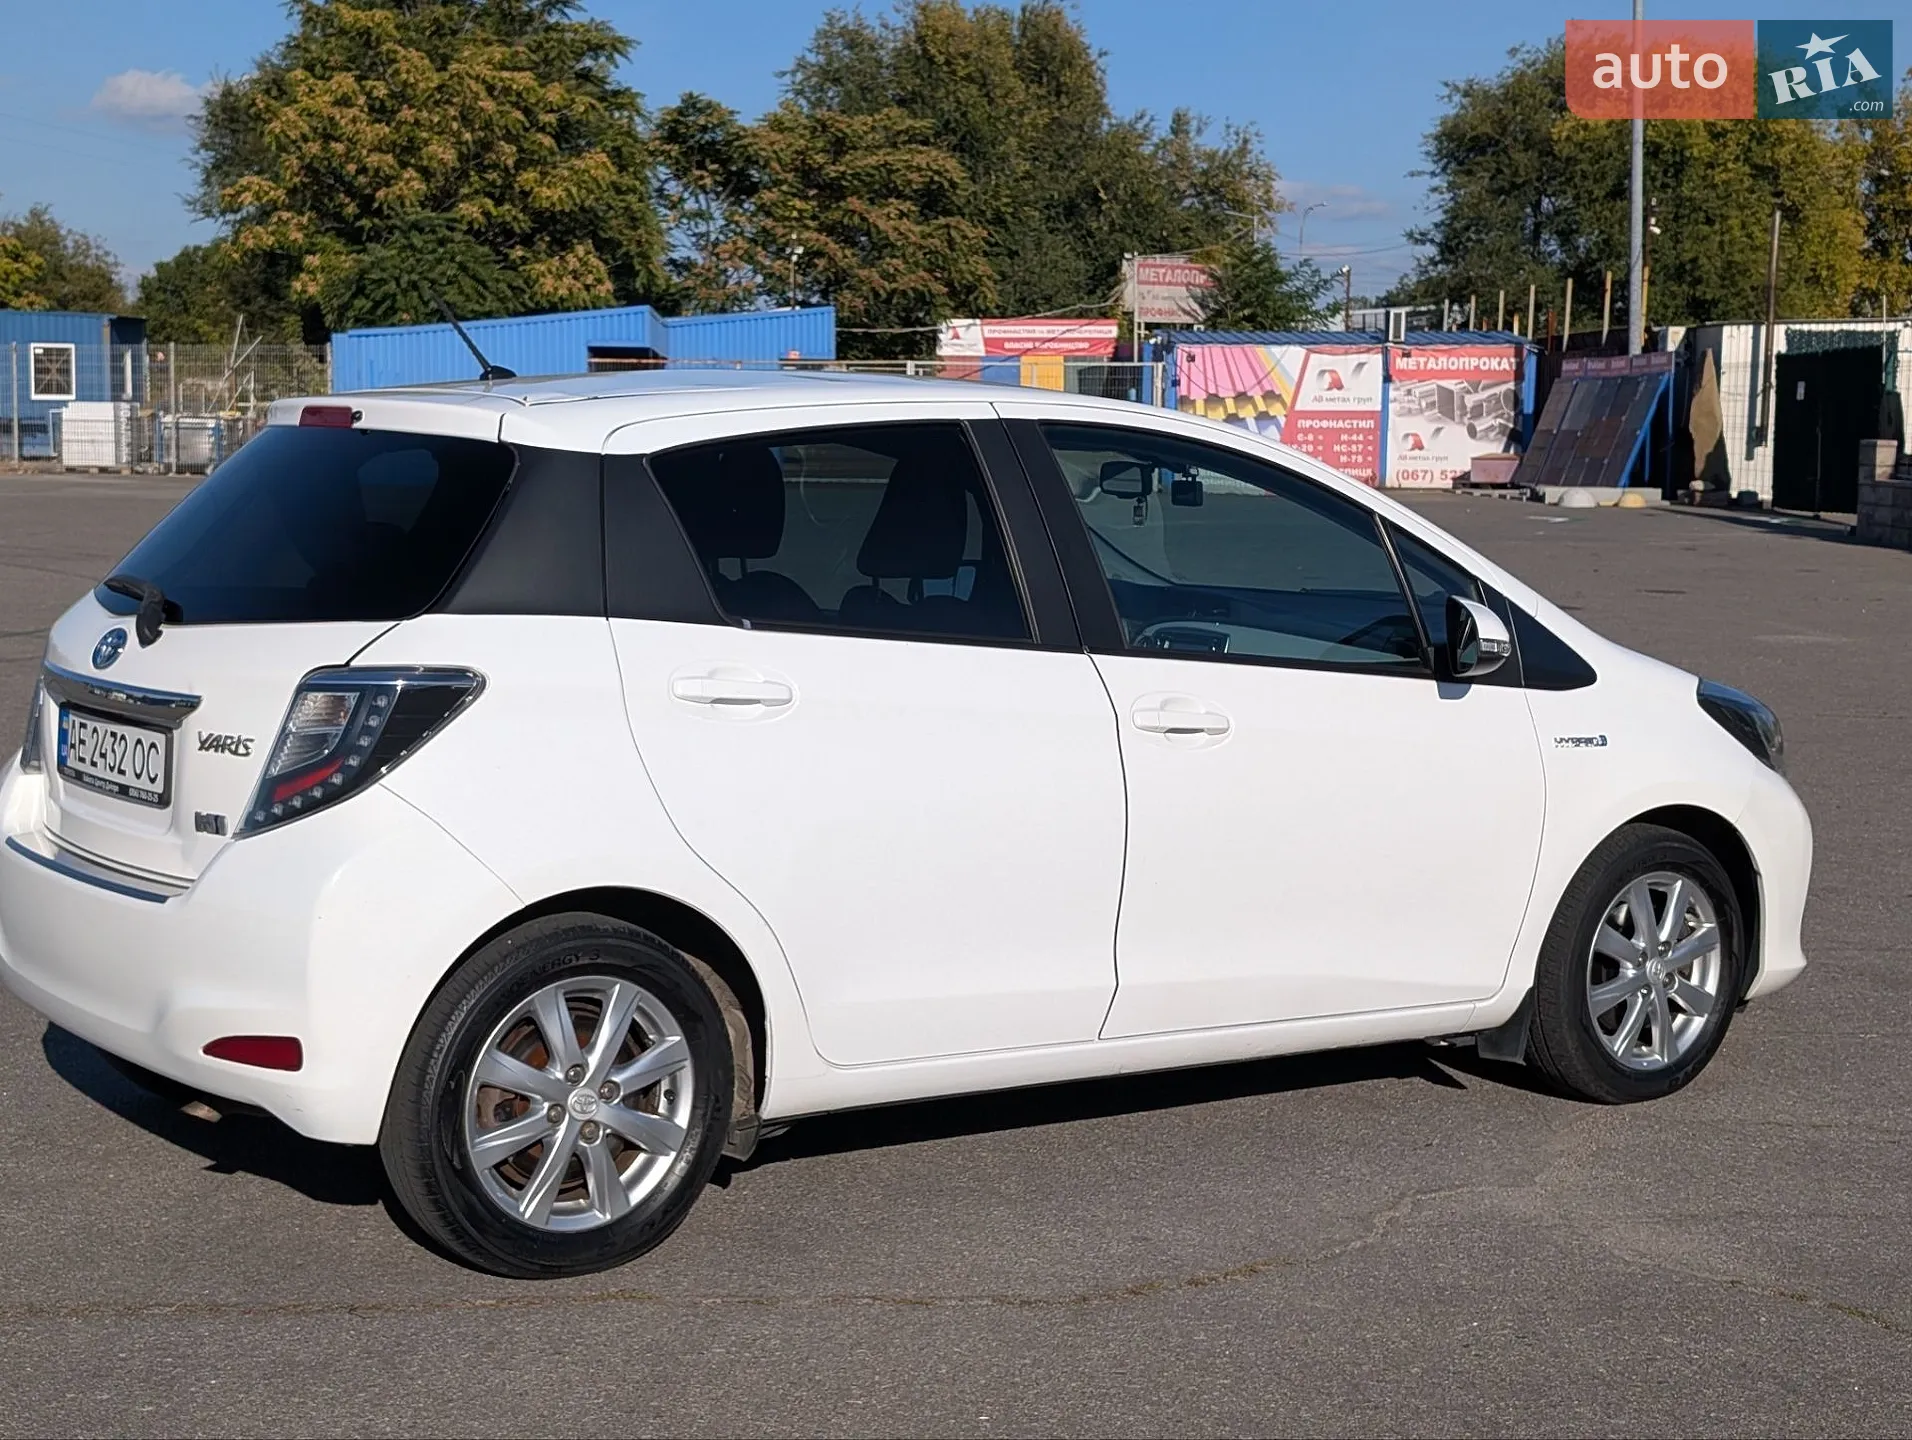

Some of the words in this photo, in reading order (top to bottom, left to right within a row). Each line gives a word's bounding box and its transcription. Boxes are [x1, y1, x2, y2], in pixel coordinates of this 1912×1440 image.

[1395, 356, 1517, 371] МЕТАЛОПРОКАТ
[1297, 419, 1375, 430] ПРОФНАСТИЛ
[1396, 469, 1434, 484] (067)
[198, 730, 255, 757] YARIS
[69, 719, 88, 764] AE
[90, 725, 128, 776] 2432
[132, 737, 160, 784] OC
